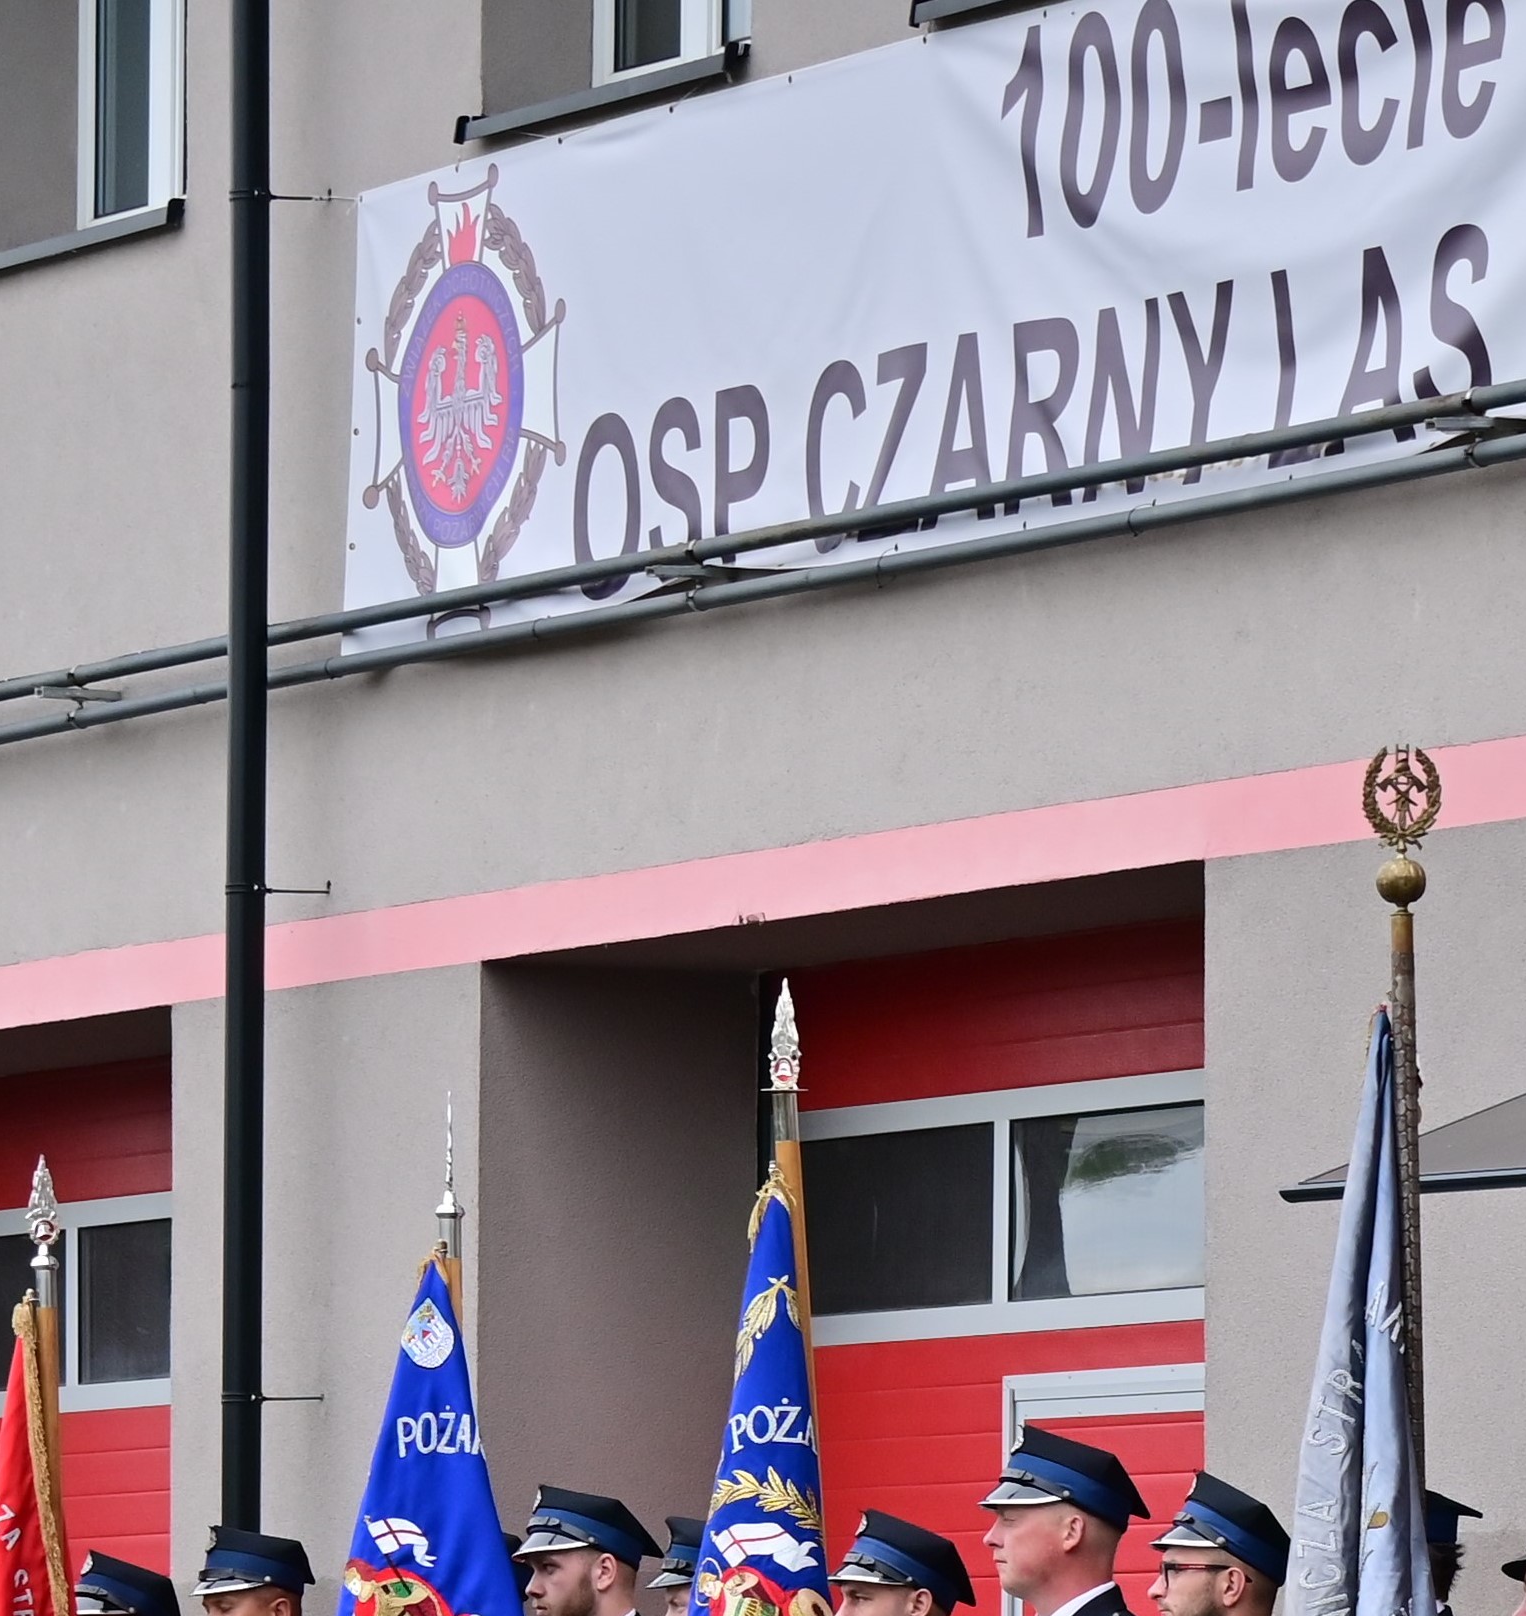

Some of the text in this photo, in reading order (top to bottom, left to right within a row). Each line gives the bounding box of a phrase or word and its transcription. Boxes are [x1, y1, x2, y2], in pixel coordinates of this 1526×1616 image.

[1002, 0, 1506, 238] 100-lecie
[572, 384, 770, 600] OSP
[805, 278, 1234, 556] CZARNY
[1270, 222, 1492, 468] LAS
